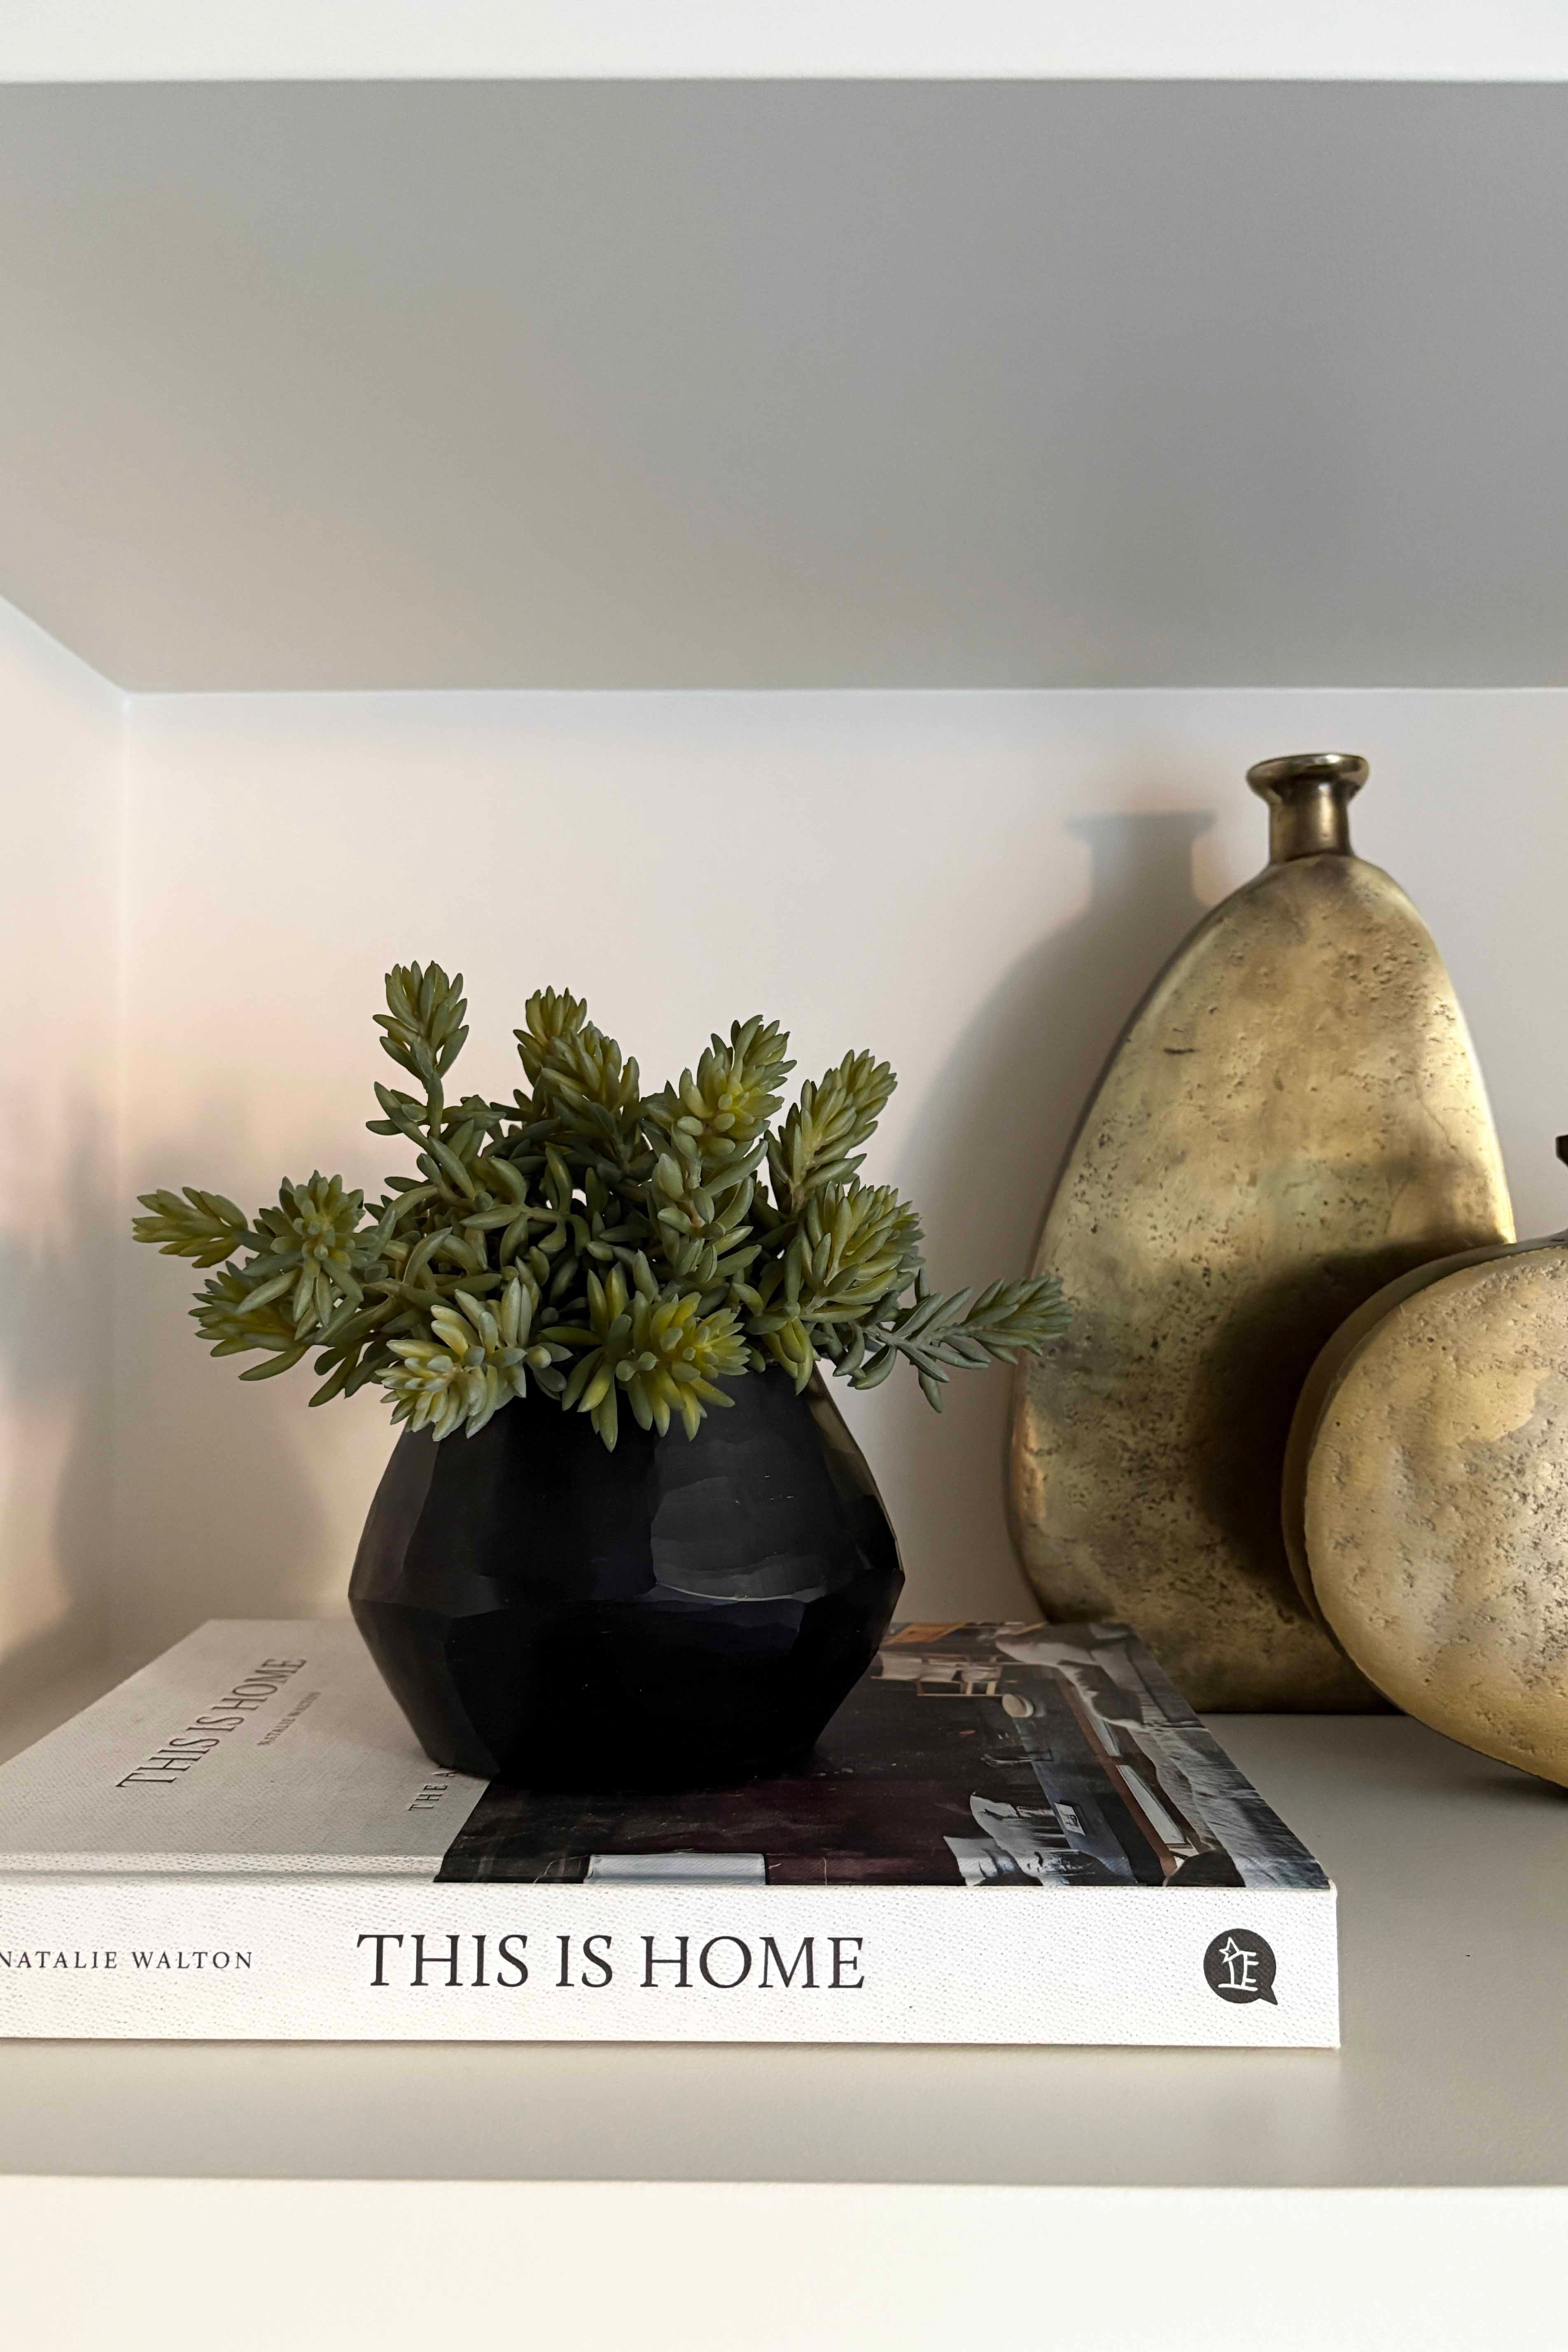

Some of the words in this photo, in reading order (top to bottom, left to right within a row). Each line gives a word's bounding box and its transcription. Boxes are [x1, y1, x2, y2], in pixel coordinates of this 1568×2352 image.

[211, 1659, 307, 1710] HOME
[185, 1716, 245, 1732] IS
[115, 1738, 220, 1788] THIS
[408, 1785, 449, 1811] THE
[0, 1951, 117, 1969] NATALIE
[131, 1951, 252, 1969] WALTON
[357, 1934, 528, 1988] THIS
[555, 1935, 613, 1988] IS
[640, 1936, 865, 1989] HOME
